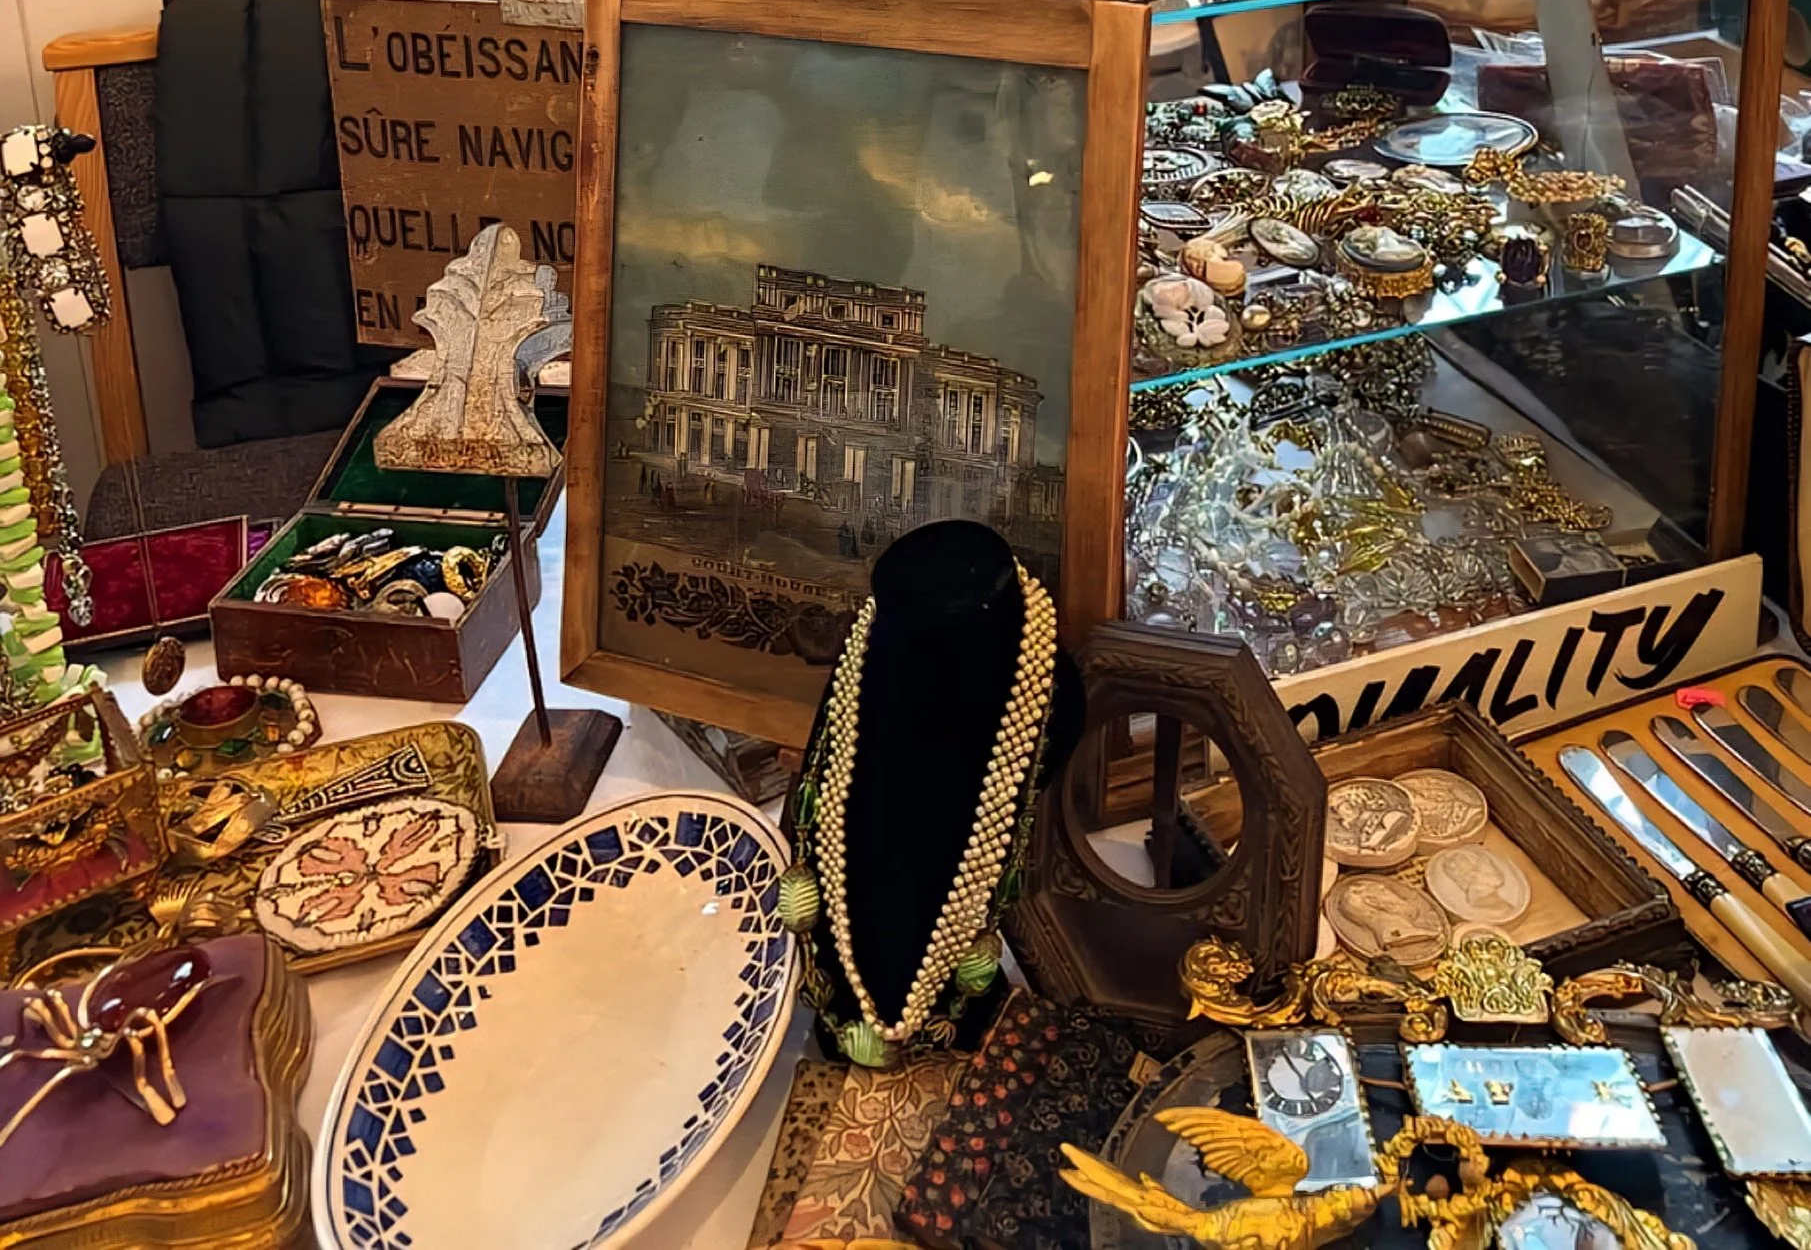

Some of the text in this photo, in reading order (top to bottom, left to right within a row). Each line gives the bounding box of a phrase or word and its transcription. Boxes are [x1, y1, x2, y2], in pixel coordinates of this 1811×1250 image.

[333, 15, 583, 84] L'OBÉISSAN
[339, 106, 574, 173] SÛRE NAVIG
[350, 204, 503, 258] QUELL
[355, 288, 402, 331] EN
